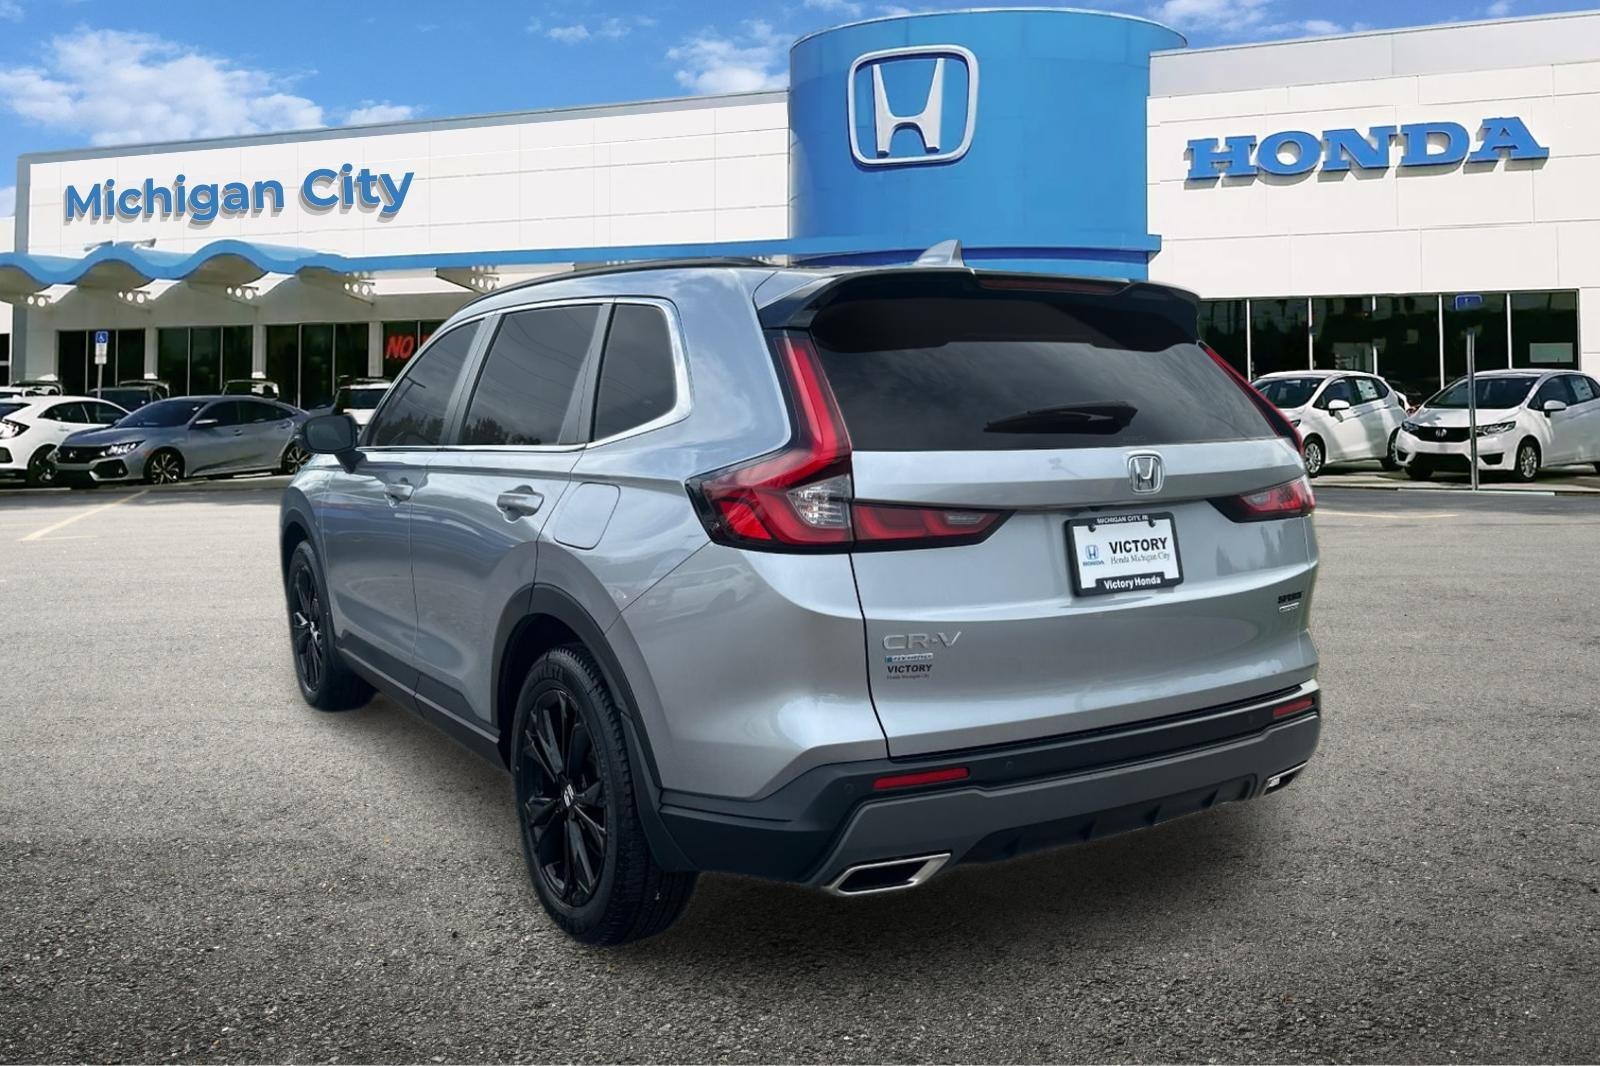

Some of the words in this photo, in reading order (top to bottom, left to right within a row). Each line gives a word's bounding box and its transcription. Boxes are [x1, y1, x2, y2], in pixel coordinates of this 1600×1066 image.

[1186, 116, 1550, 180] HONDA
[66, 174, 285, 222] Michigan
[302, 163, 415, 215] City
[385, 334, 415, 359] NO
[1109, 537, 1168, 554] VICTORY
[1111, 556, 1130, 565] Honda
[1130, 554, 1157, 563] Michigan
[1158, 551, 1170, 561] City
[1104, 579, 1134, 590] Victory
[1134, 576, 1161, 586] Honda
[883, 631, 962, 650] CR-V
[887, 664, 932, 673] VICTORY
